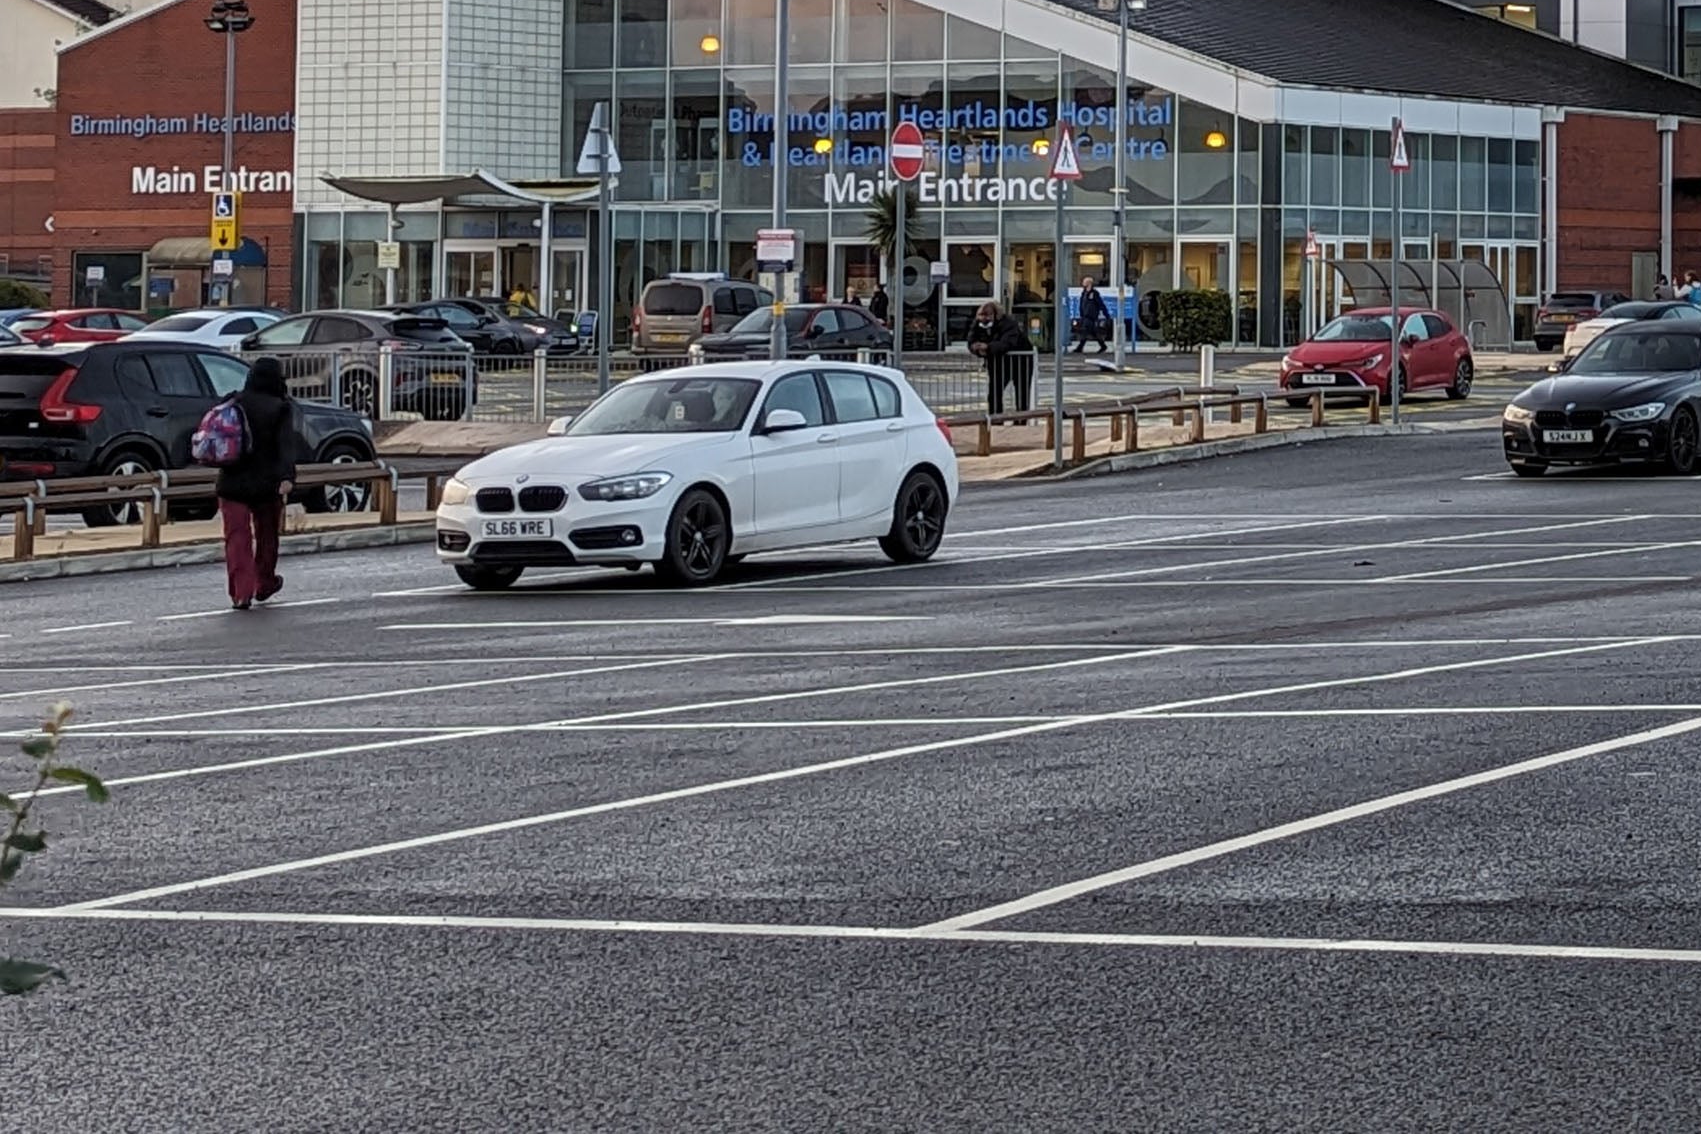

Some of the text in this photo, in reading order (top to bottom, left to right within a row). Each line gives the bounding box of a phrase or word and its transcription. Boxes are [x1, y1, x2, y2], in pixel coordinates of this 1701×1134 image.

[70, 114, 187, 137] Birmingham
[899, 99, 1048, 129] Heartlands
[743, 141, 762, 167] &
[132, 165, 296, 194] Main Entran
[919, 170, 1068, 203] Entrance
[485, 521, 517, 536] SL66
